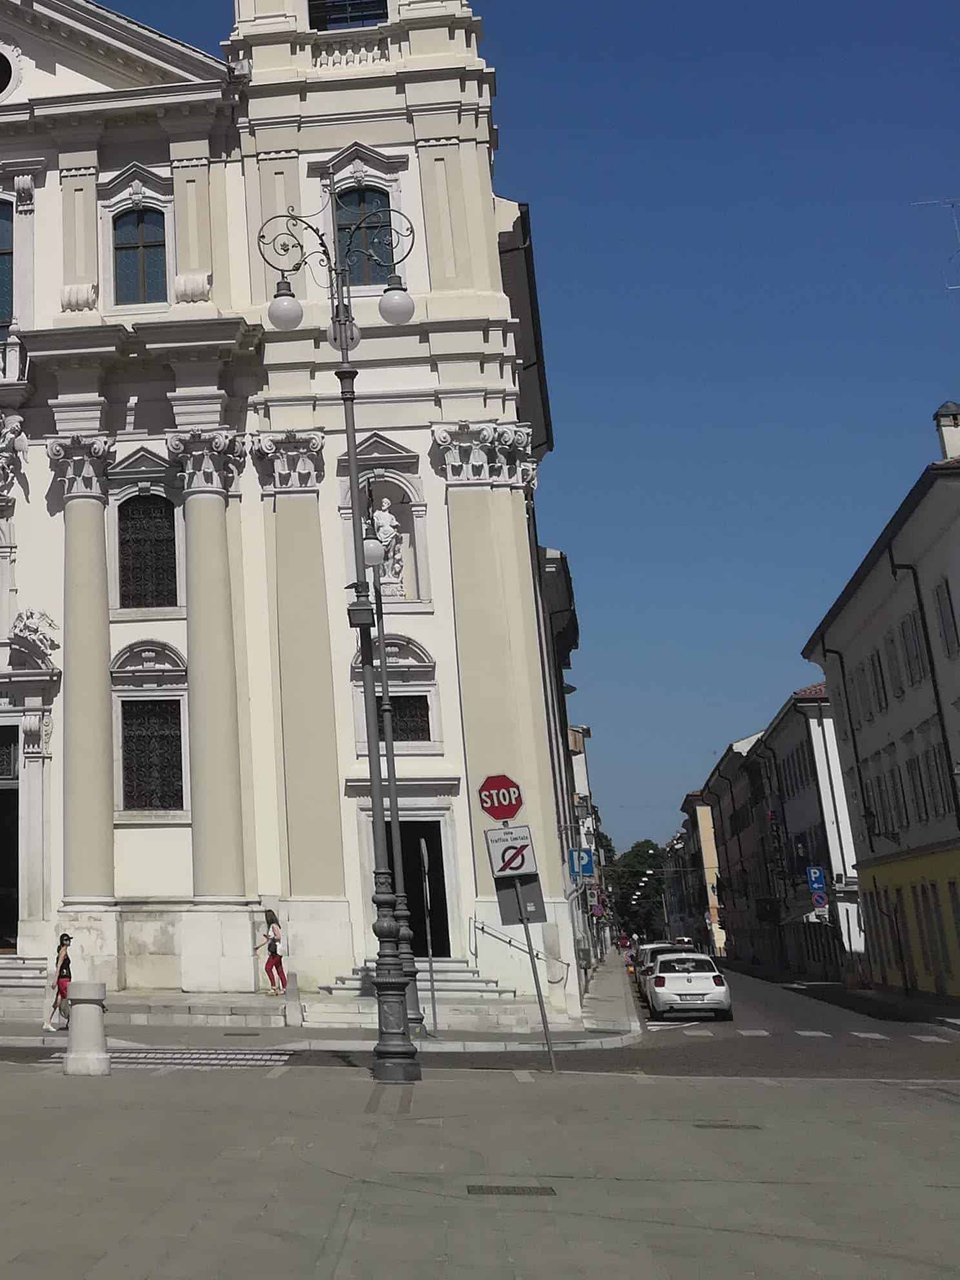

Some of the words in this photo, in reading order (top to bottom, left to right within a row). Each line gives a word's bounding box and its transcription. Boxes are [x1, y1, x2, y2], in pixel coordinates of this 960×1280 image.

[481, 787, 519, 808] STOP
[573, 851, 588, 872] P
[810, 868, 820, 881] P
